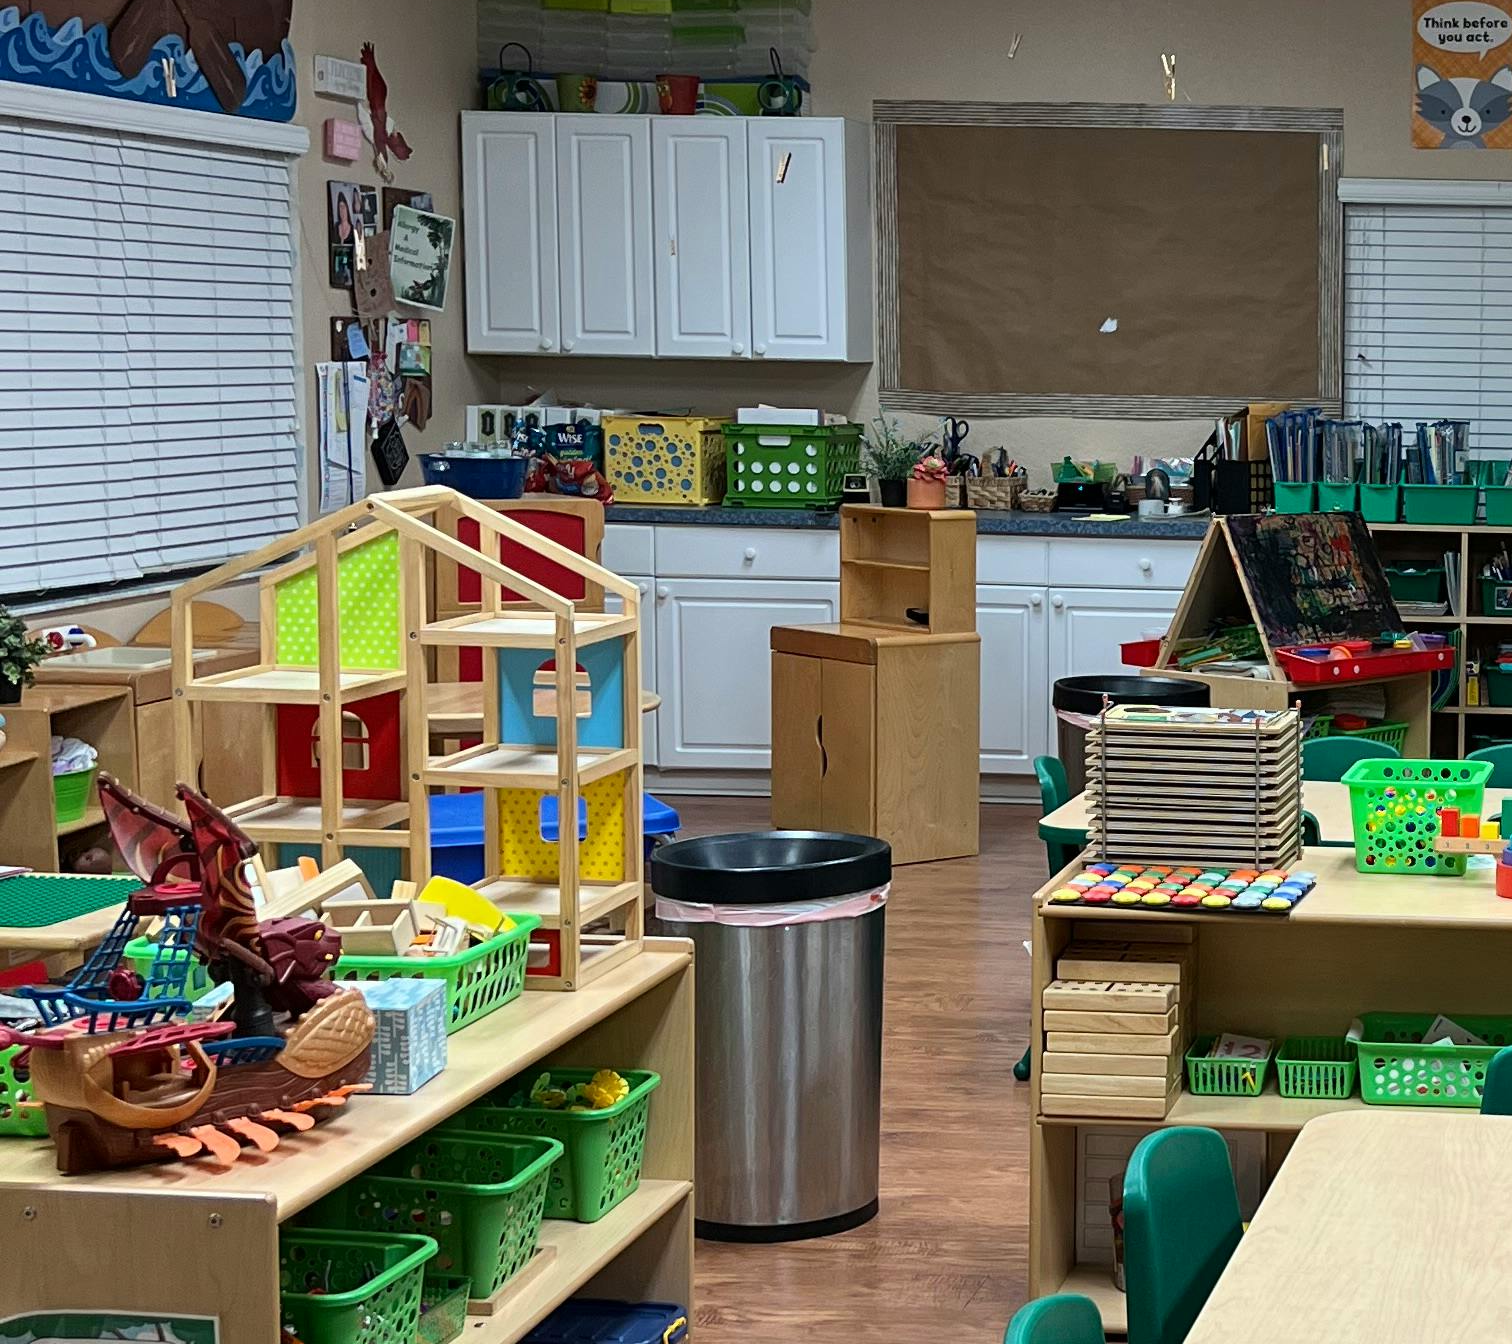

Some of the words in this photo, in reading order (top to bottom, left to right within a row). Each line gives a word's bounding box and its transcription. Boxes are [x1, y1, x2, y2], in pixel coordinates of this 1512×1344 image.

[1423, 17, 1459, 28] Think
[1463, 16, 1508, 28] before
[1438, 33, 1462, 45] you
[1466, 31, 1494, 43] act.
[557, 432, 583, 444] WISE
